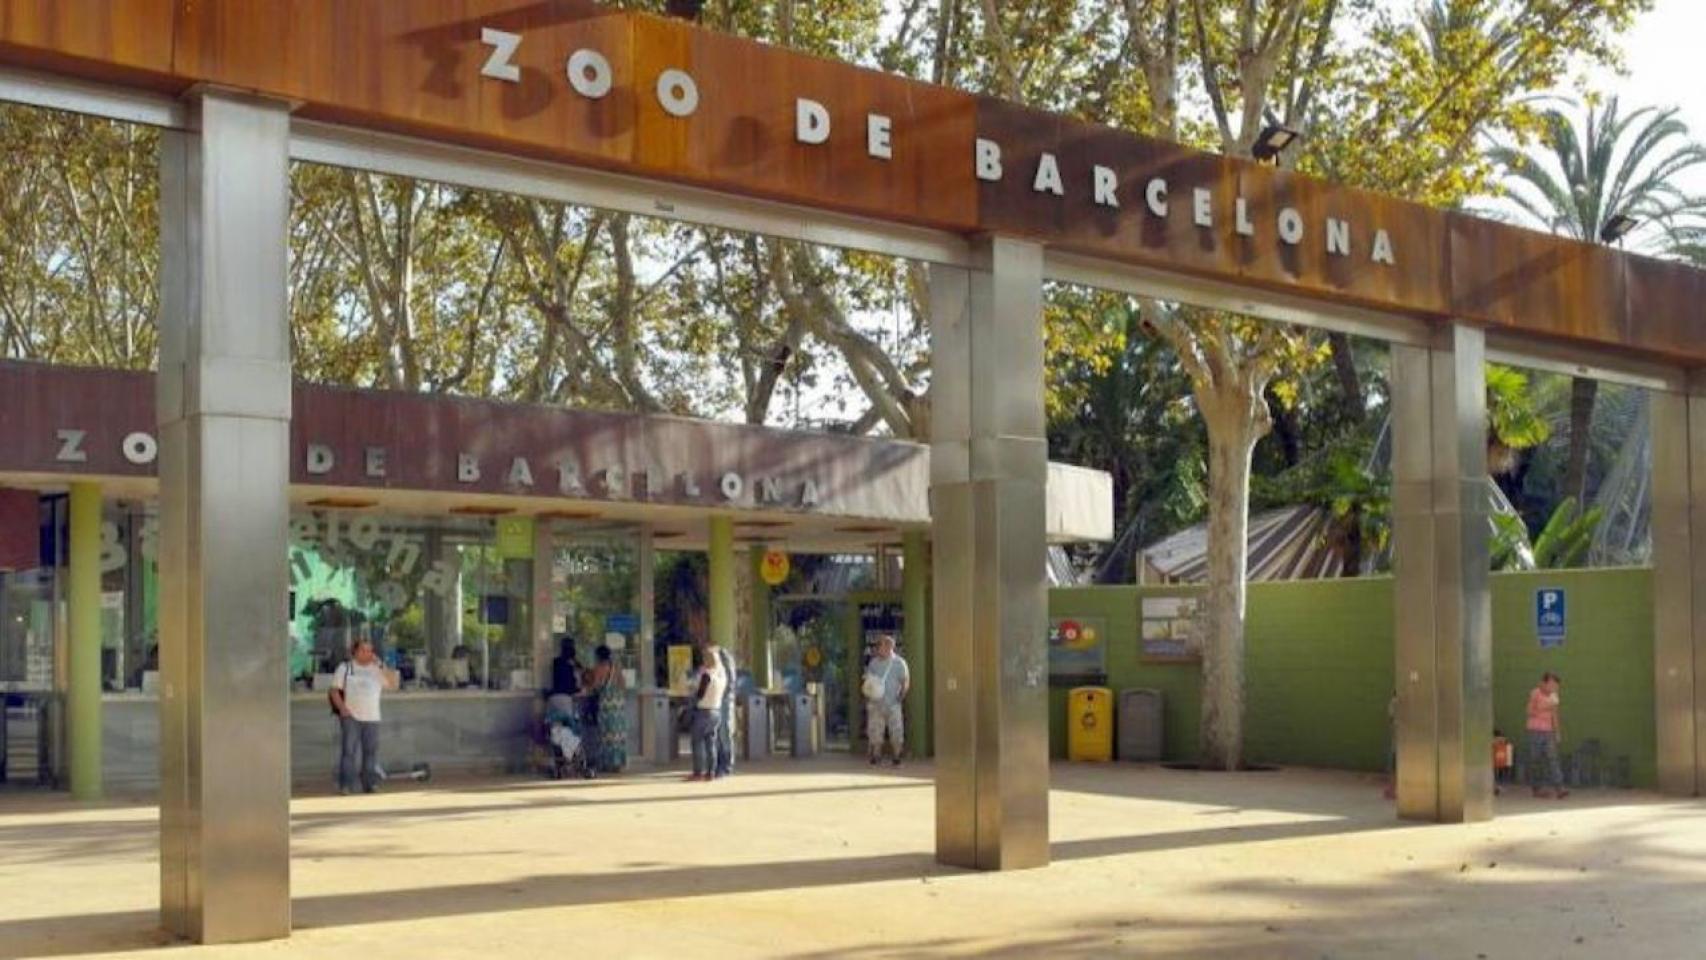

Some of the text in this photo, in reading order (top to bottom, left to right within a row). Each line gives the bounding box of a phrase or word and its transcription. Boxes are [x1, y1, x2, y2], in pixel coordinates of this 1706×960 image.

[481, 27, 1396, 265] ZOO DE BARCELONA
[56, 429, 158, 464] ZO
[307, 444, 386, 476] DE
[1543, 592, 1557, 609] P
